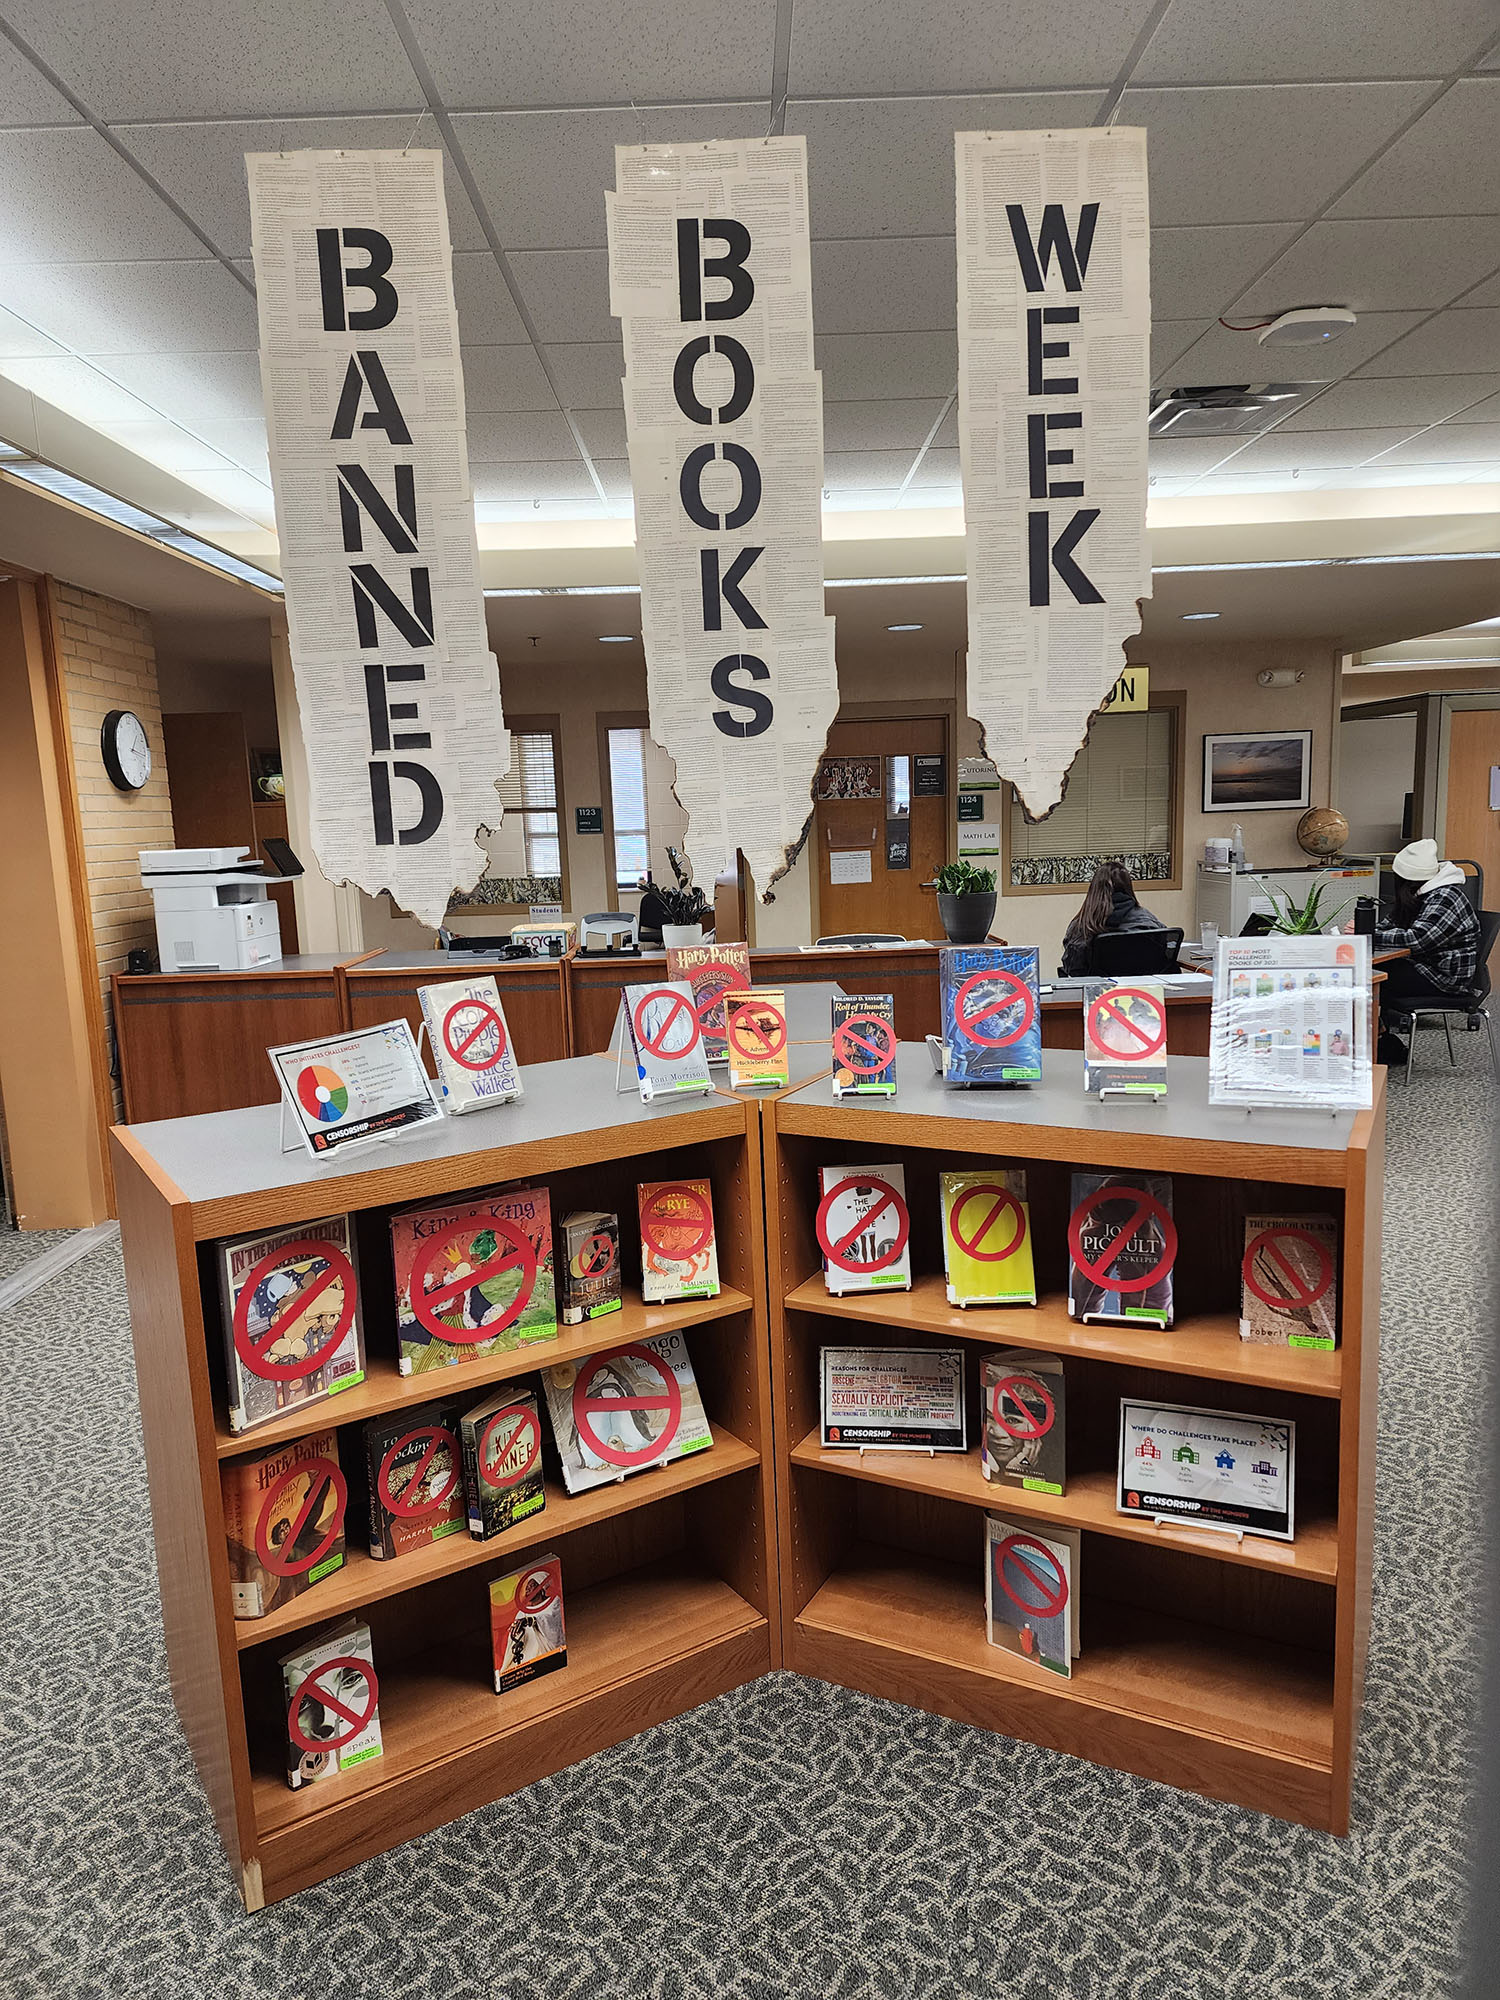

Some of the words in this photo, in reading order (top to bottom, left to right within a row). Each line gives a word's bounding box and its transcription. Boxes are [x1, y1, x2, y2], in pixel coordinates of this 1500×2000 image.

[1005, 202, 1107, 607] WEEK
[673, 218, 774, 738] BOOKS
[316, 228, 444, 845] BANNED
[960, 796, 977, 804] 1124
[579, 808, 597, 816] 1123
[676, 950, 711, 970] Harry
[709, 947, 747, 972] Potter
[953, 952, 992, 973] Harry
[992, 950, 1036, 972] Potter
[835, 1003, 851, 1011] Roll
[851, 1003, 859, 1012] of
[859, 1002, 890, 1010] Thunder,
[879, 1011, 892, 1019] Cry
[736, 1059, 770, 1067] Huckleberry
[650, 1074, 668, 1084] Toni
[670, 1070, 706, 1081] Morrison
[471, 1076, 517, 1097] Walker
[326, 1122, 369, 1141] CENSORSHIP
[488, 1201, 536, 1220] King
[667, 1198, 690, 1211] RYE
[231, 1251, 245, 1278] IN
[1130, 1256, 1159, 1264] KEEPER
[580, 1276, 613, 1295] JULIE
[1250, 1328, 1282, 1337] robert
[831, 1393, 869, 1405] SEXUALLY
[871, 1393, 905, 1406] EXPLICIT
[868, 1408, 893, 1418] CRITICAL
[894, 1409, 909, 1418] RACE
[909, 1410, 930, 1419] THEORY
[930, 1412, 955, 1420] PROFANITY
[842, 1429, 892, 1438] CENSORSHIP
[1131, 1424, 1156, 1433] WHERE
[1169, 1430, 1212, 1441] CHALLENGES
[1213, 1435, 1231, 1444] TAKE
[1231, 1437, 1257, 1448] PLACE?
[382, 1436, 398, 1449] TO
[255, 1453, 294, 1492] Harry
[292, 1435, 333, 1464] Potter
[1143, 1495, 1201, 1511] CENSORSHIP
[400, 1526, 433, 1543] HARPER
[346, 1734, 378, 1754] speak
